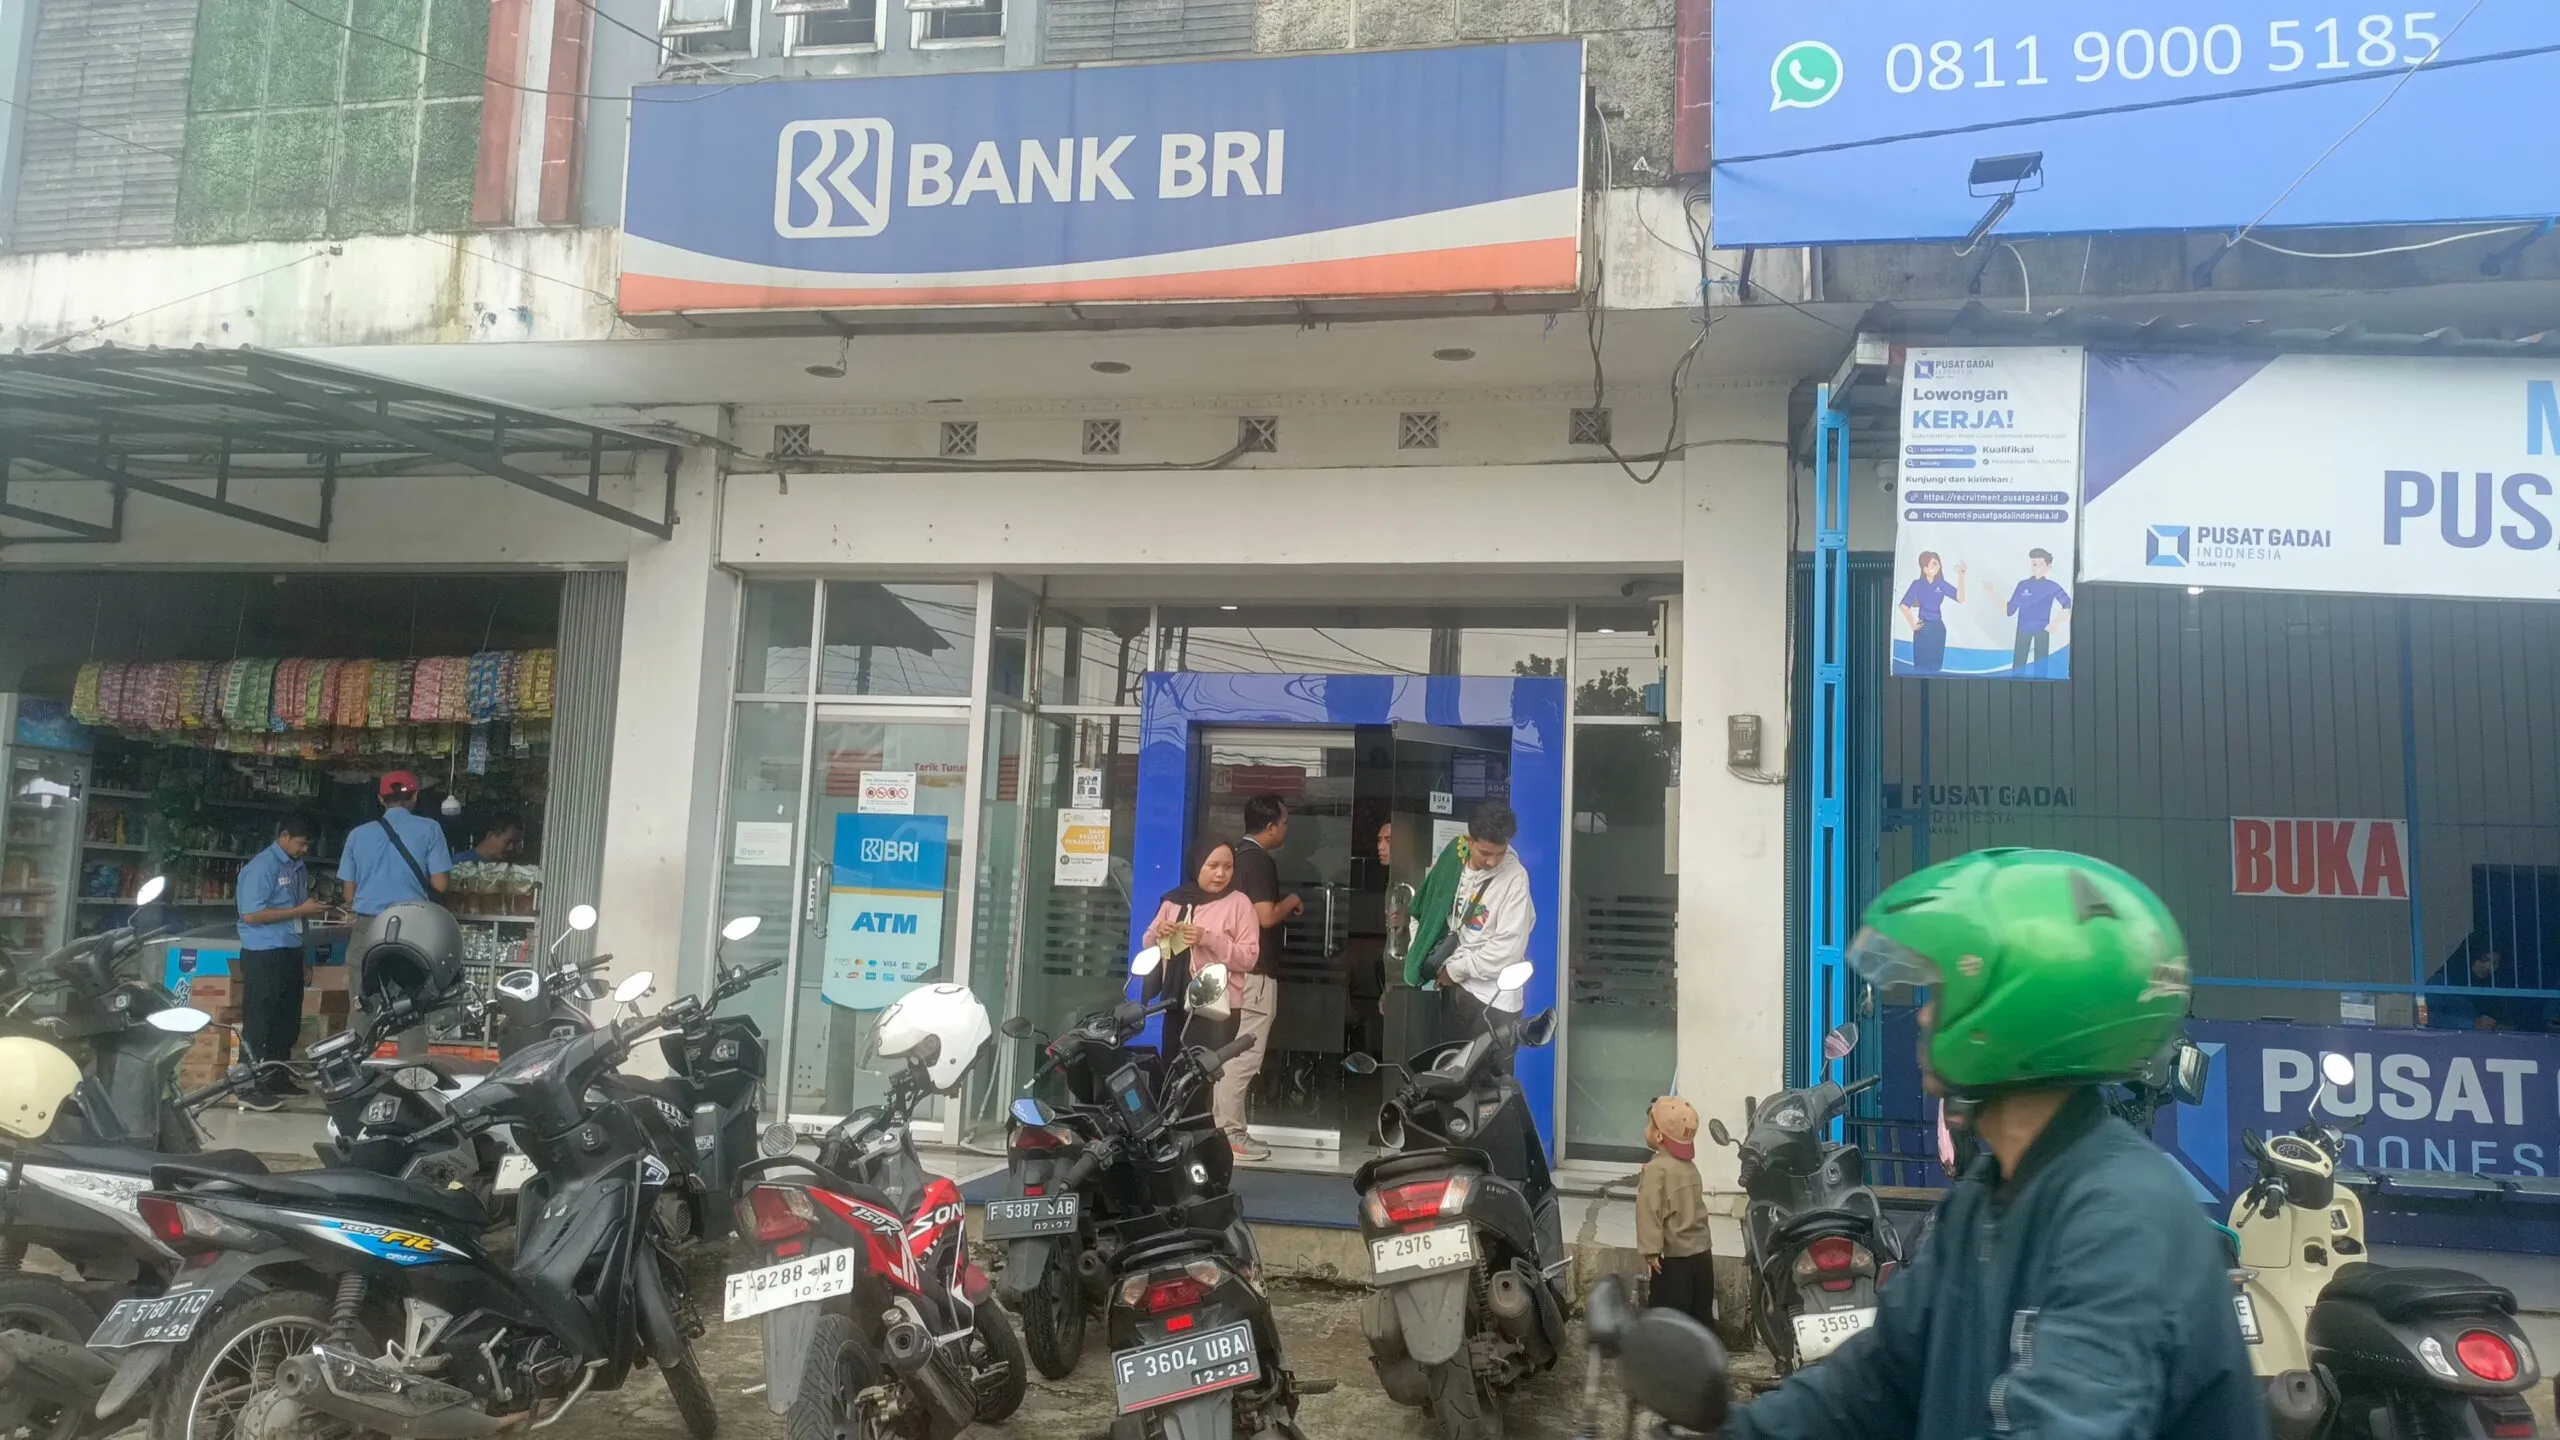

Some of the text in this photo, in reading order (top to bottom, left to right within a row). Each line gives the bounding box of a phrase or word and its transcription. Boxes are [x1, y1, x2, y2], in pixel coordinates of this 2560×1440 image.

[1885, 12, 2441, 94] 0811 9000 5185
[907, 129, 1285, 207] BANK BRI
[1936, 360, 1994, 369] PUSAT GADAI
[1913, 388, 2008, 403] Lowongan
[1913, 410, 2014, 429] KERJA!
[1983, 446, 2034, 454] Kualifikasi
[1906, 476, 1946, 484] Kunjungi
[1948, 475, 1965, 483] dan
[1968, 475, 2008, 483] kirimkan
[2384, 470, 2560, 550] PUS
[2197, 526, 2331, 548] PUSAT GADAI
[2197, 547, 2282, 561] INDONESIA
[1433, 794, 1450, 803] BUKA
[884, 840, 919, 862] BRI
[2234, 820, 2407, 897] BUKA
[851, 912, 917, 934] ATM
[2262, 1048, 2538, 1125] PUSAT
[991, 1206, 998, 1220] F
[1006, 1203, 1039, 1218] 5387
[1376, 1228, 1468, 1261] F 2976 Z
[733, 1279, 742, 1298] F
[108, 1295, 206, 1322] F 5780 TAC
[1797, 1314, 1860, 1336] F 3599
[1122, 1334, 1246, 1383] F 3604 UBA
